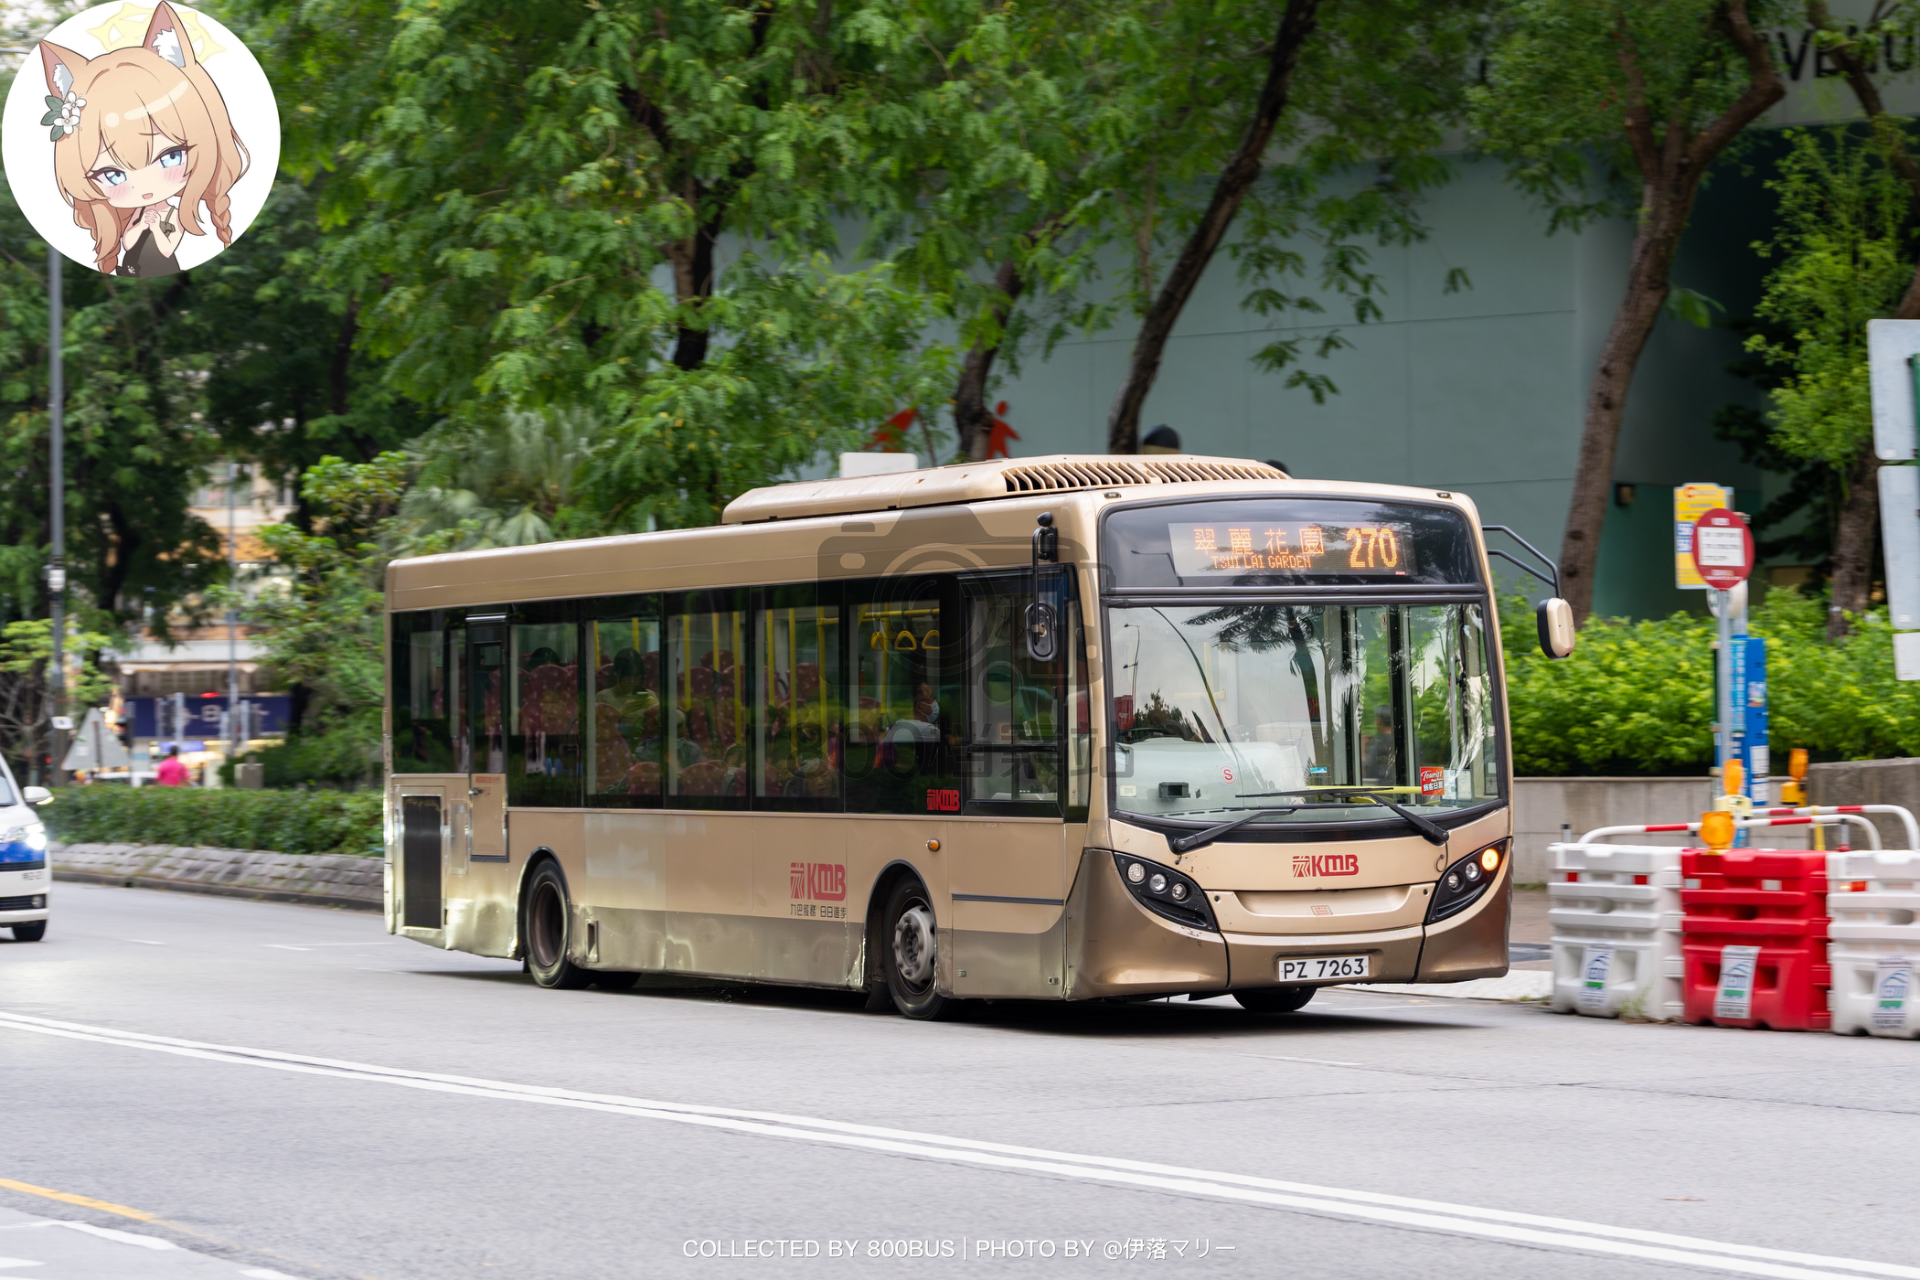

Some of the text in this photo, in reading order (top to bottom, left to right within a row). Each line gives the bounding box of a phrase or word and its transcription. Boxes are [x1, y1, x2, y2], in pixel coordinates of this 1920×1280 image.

[1193, 528, 1325, 555] 翠麗花園
[1346, 528, 1398, 568] 270
[1210, 555, 1312, 569] TSUI LAI GARDEN
[1223, 769, 1233, 781] S
[936, 789, 960, 811] KMB
[1311, 854, 1360, 877] KMB
[807, 863, 846, 901] KMB
[1283, 957, 1365, 980] PZ 7263
